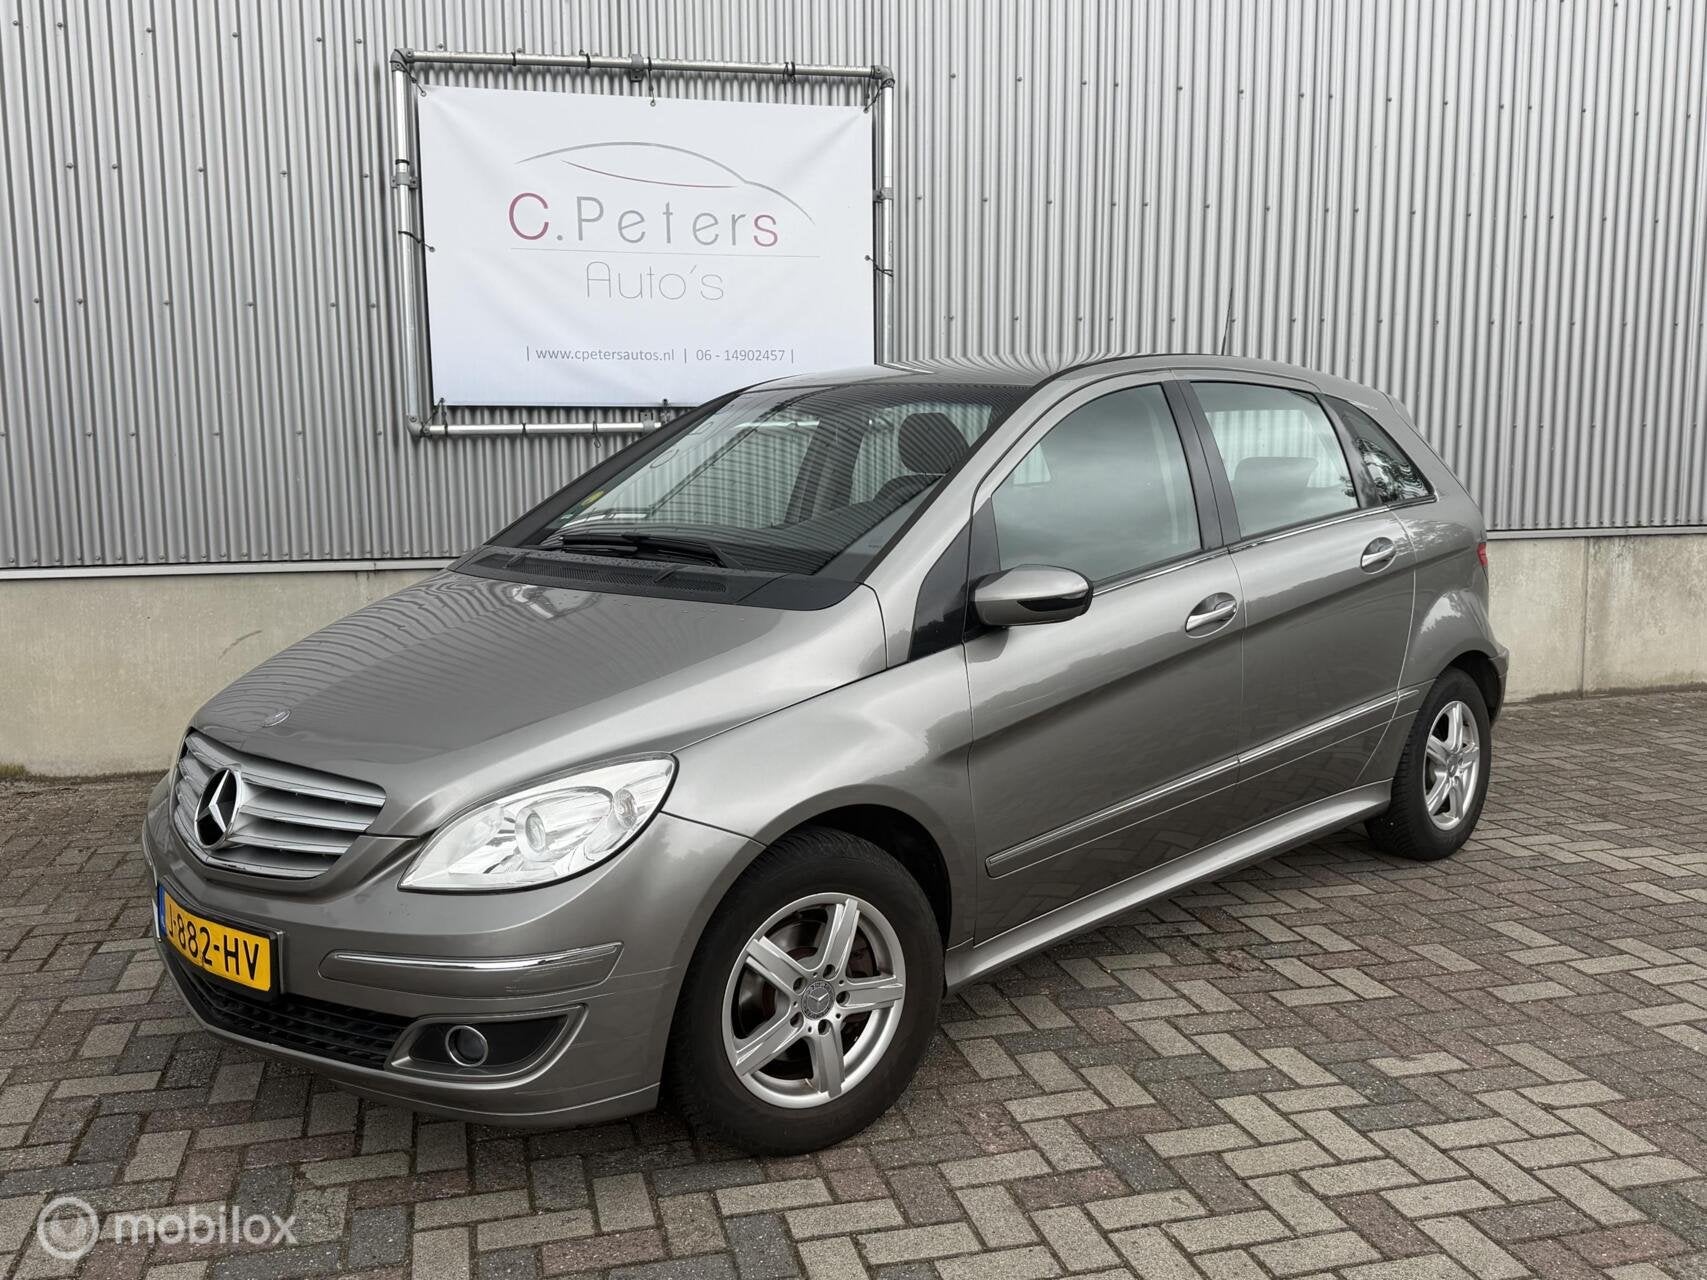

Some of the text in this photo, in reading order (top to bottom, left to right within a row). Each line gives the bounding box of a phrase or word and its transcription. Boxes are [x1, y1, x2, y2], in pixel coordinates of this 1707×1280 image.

[508, 192, 779, 247] C.Peters
[535, 349, 675, 362] www.cpetersautos.nl
[695, 349, 712, 361] 06
[724, 349, 785, 361] 14902457
[168, 903, 260, 981] J-882-HV
